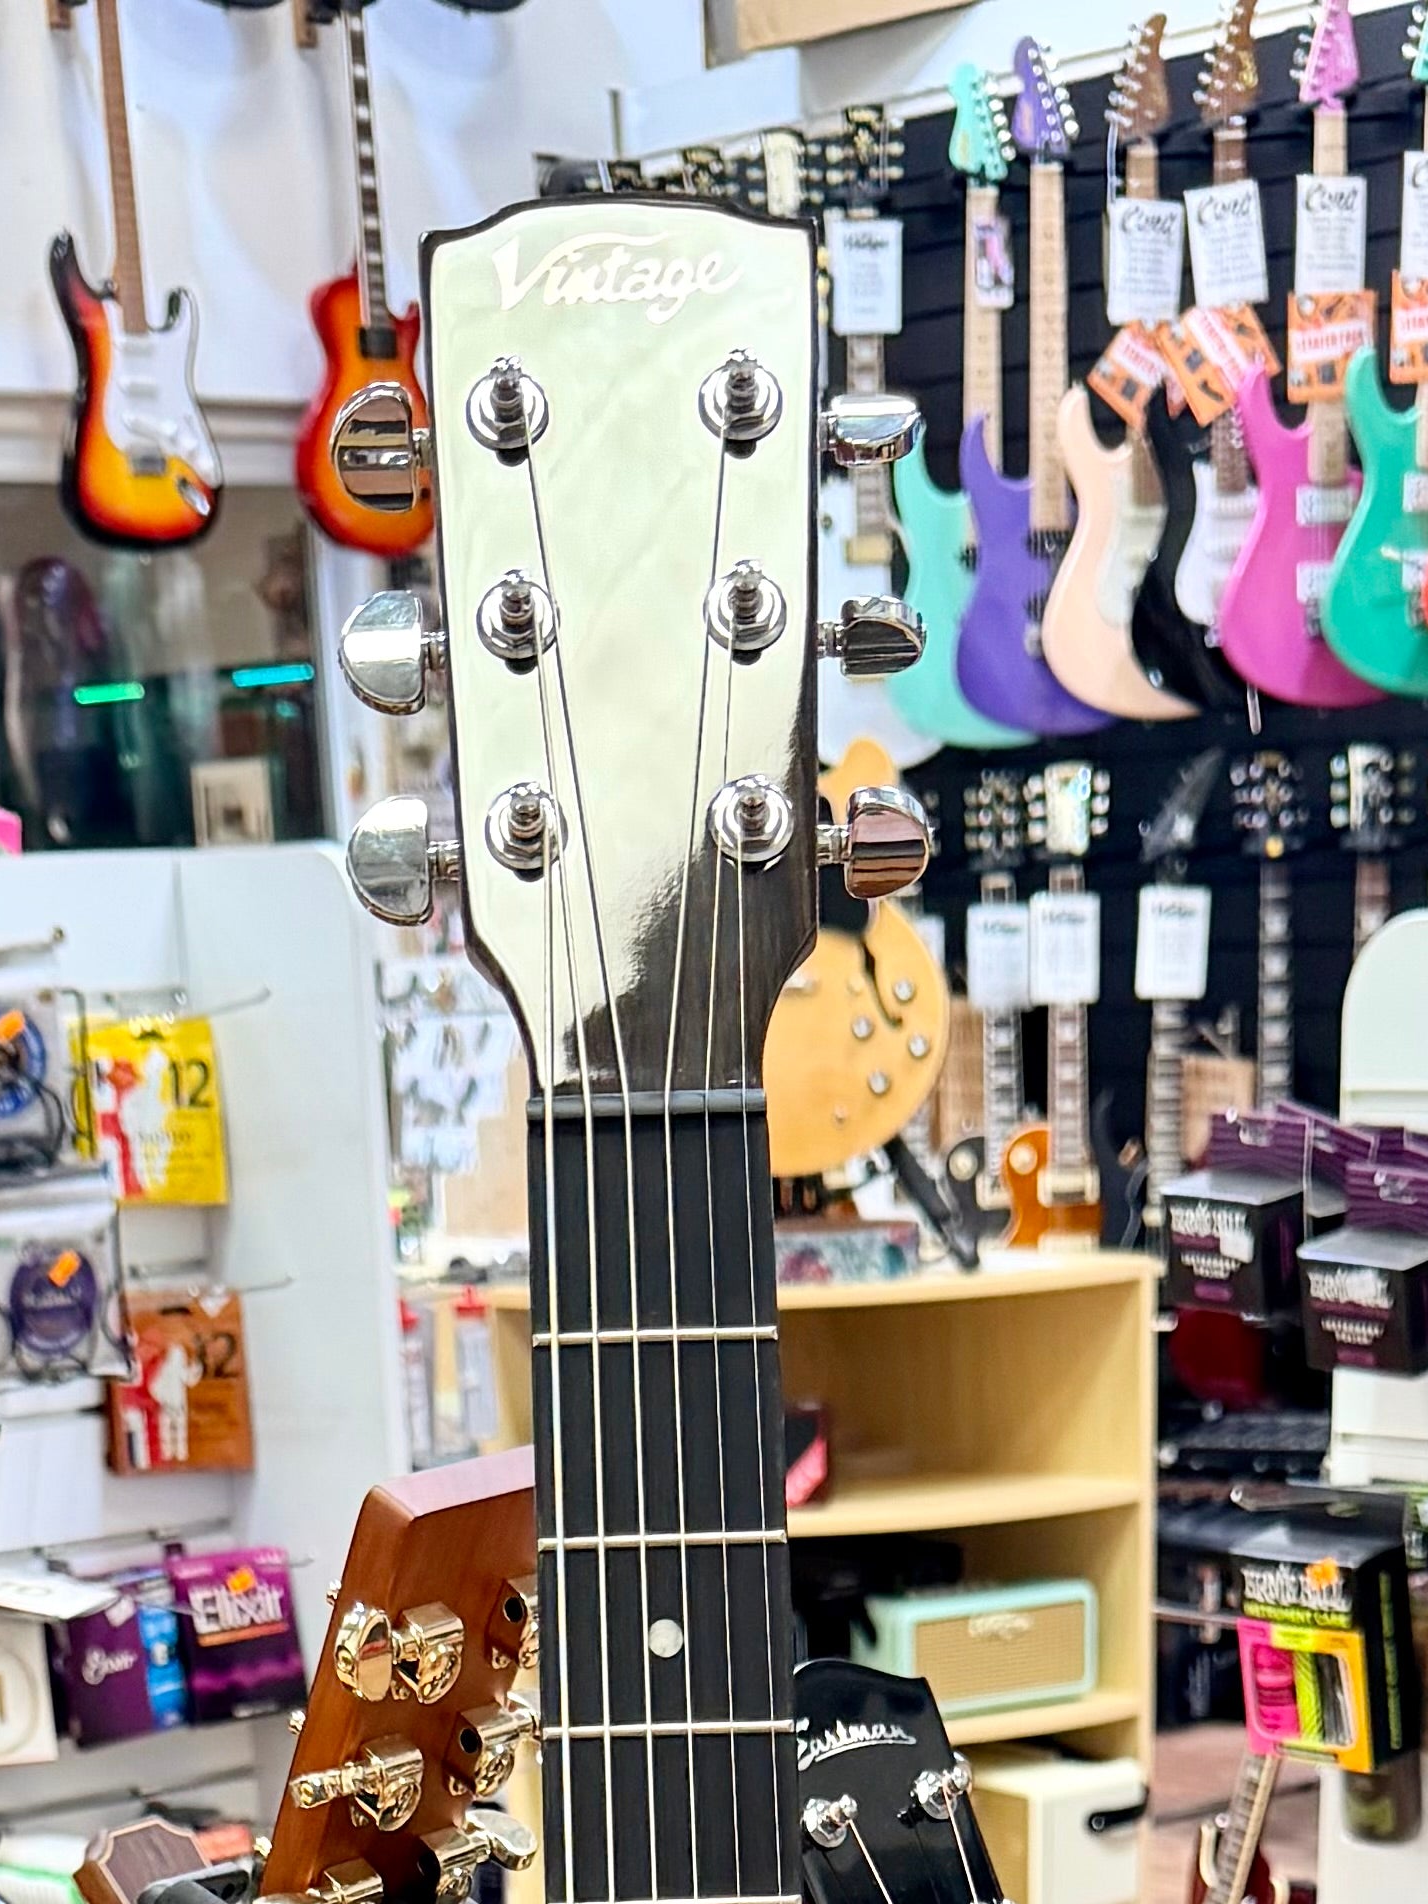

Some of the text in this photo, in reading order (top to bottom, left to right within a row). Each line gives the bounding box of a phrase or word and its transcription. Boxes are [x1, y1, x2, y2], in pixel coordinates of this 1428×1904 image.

[491, 230, 746, 326] Vintage
[168, 1059, 212, 1109] 12
[188, 1583, 284, 1635] Elixir
[798, 1718, 916, 1770] Eastman
